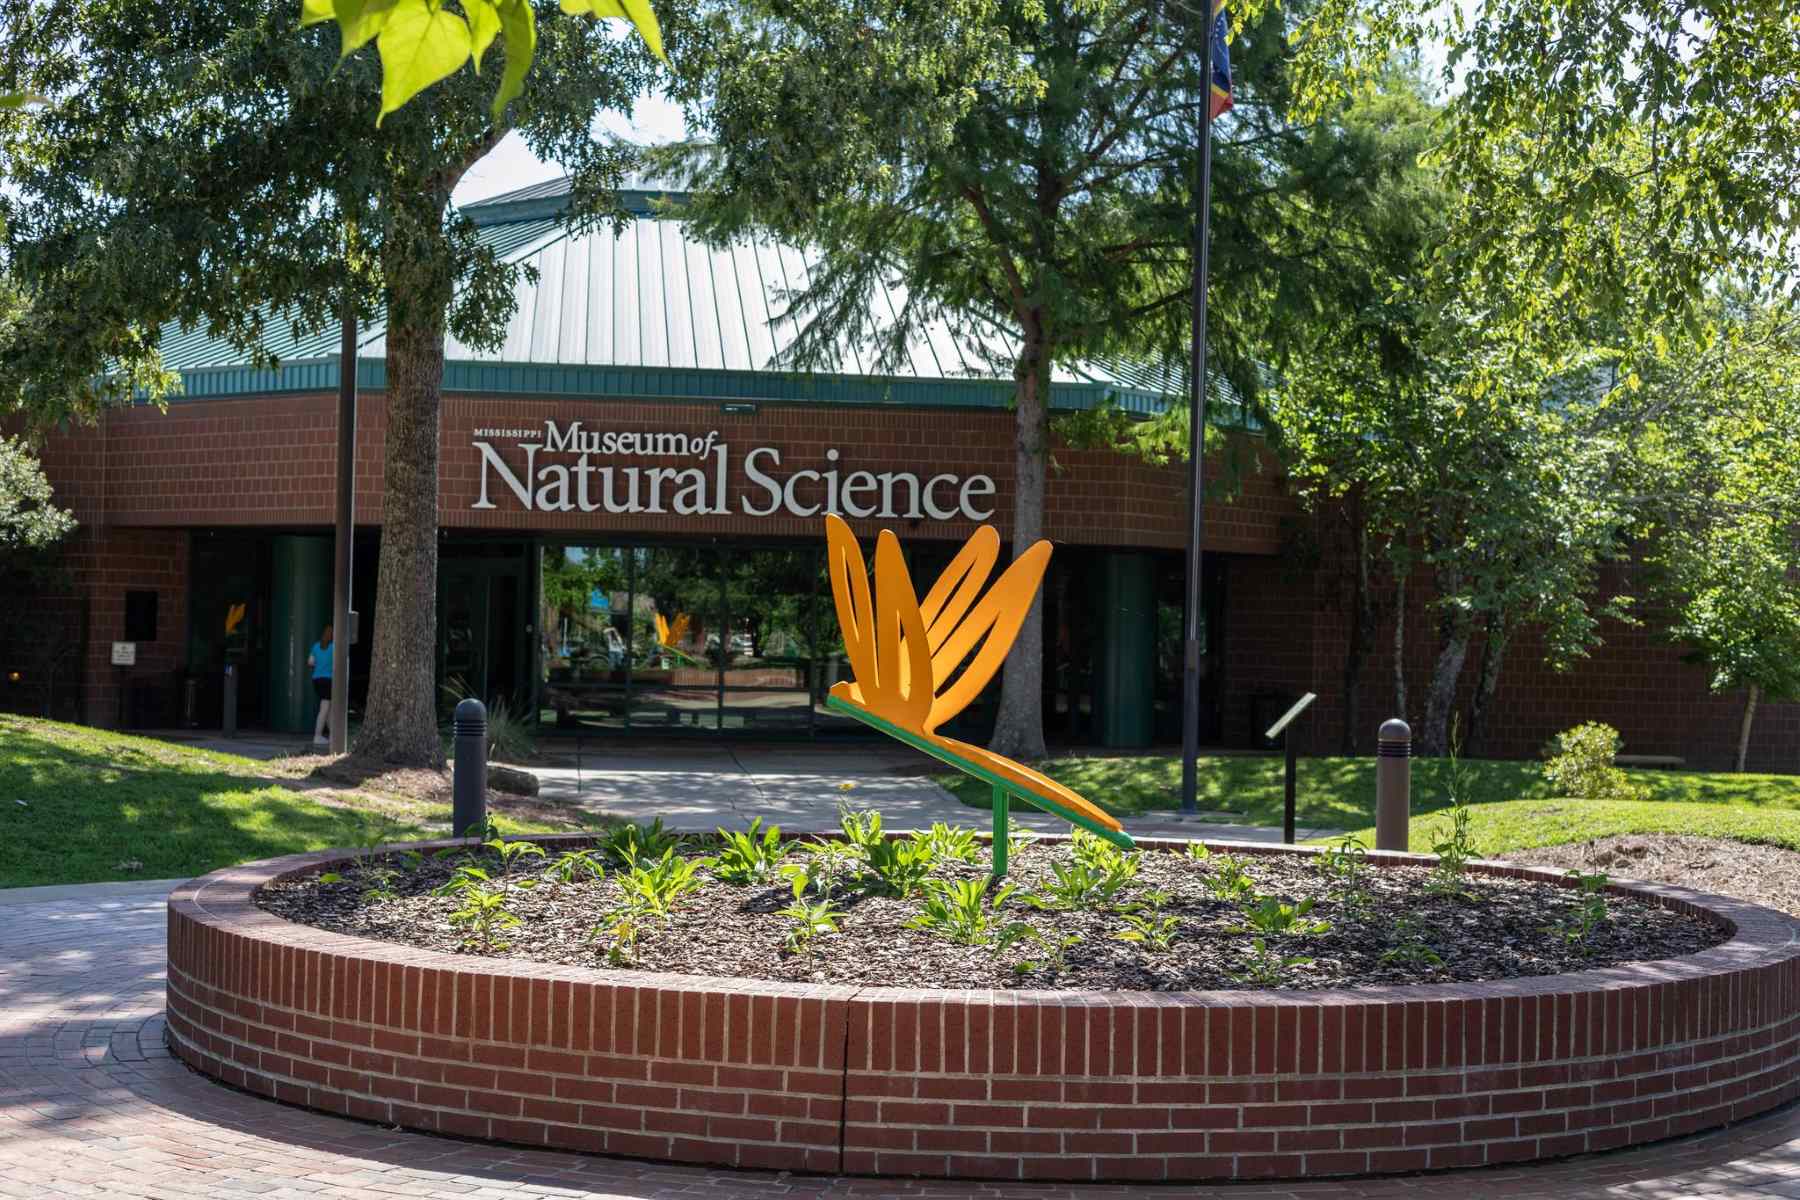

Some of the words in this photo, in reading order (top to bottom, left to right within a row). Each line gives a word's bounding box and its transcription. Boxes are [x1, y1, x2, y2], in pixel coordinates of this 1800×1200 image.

[473, 428, 542, 439] MISSISSIPPI
[543, 420, 690, 456] Museum
[690, 430, 719, 460] of
[471, 441, 733, 515] Natural
[741, 447, 996, 521] Science
